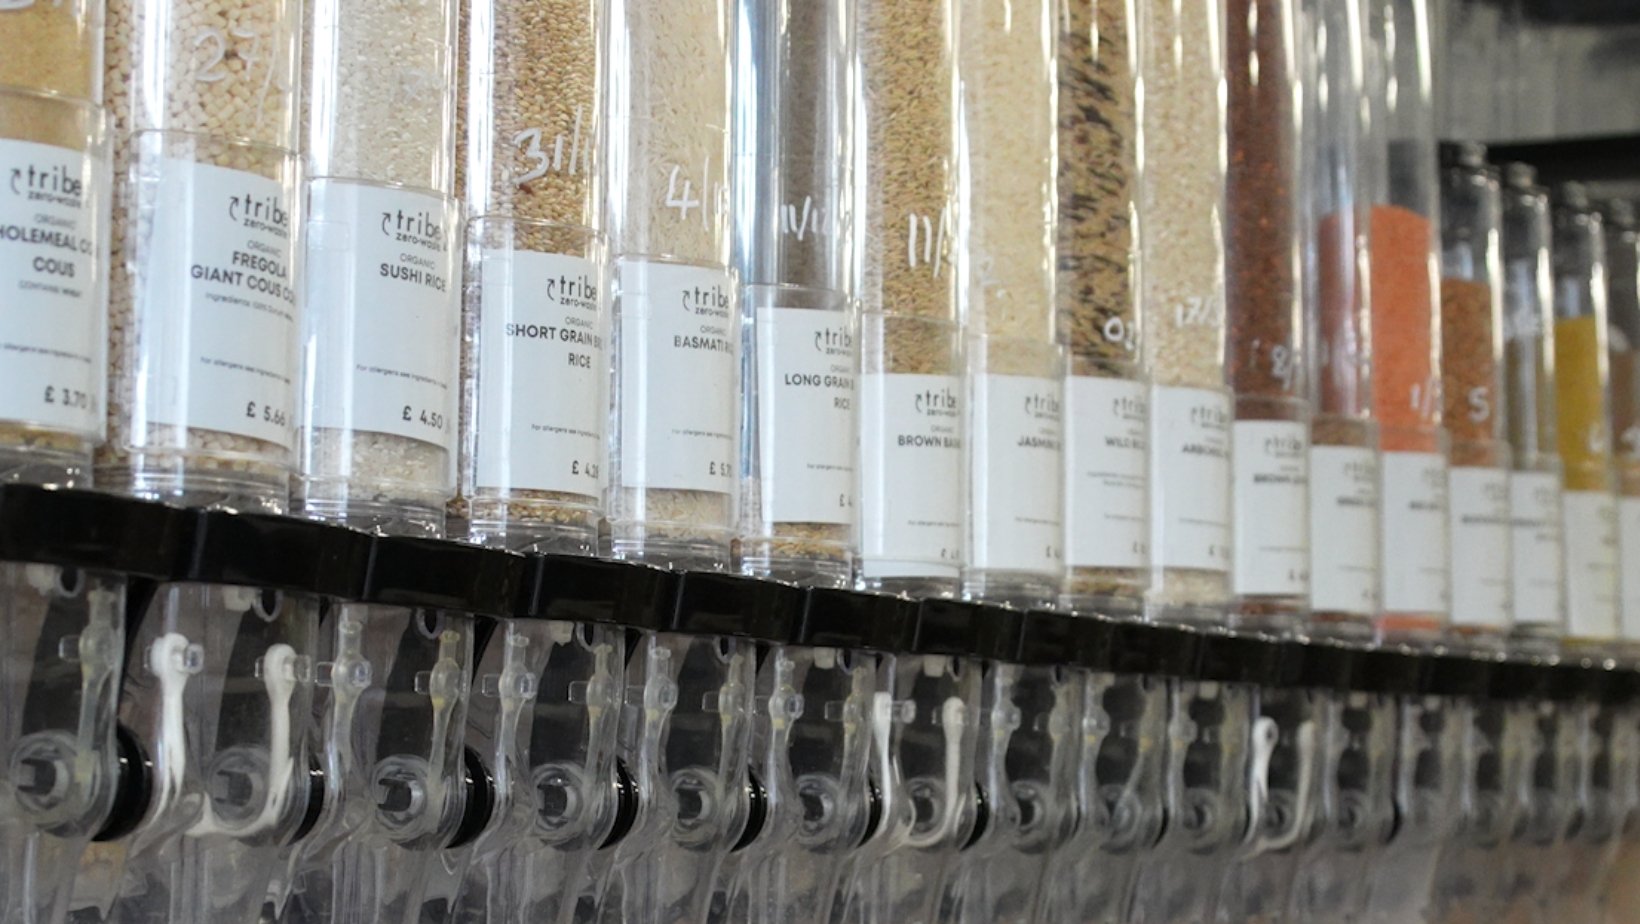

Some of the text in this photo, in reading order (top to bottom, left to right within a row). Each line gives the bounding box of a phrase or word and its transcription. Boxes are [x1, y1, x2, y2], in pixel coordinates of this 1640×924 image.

[27, 164, 82, 197] tribe
[33, 256, 75, 278] COUS
[399, 253, 436, 271] ORGANIC
[190, 264, 244, 286] GIANT
[246, 275, 281, 298] COUS
[379, 262, 446, 293] SUSHI RICE
[505, 322, 557, 341] SHORT
[559, 328, 593, 347] GRAIN
[673, 334, 724, 354] BASMATI
[567, 352, 592, 370] RICE
[784, 372, 822, 388] LONG
[44, 385, 55, 403] £
[246, 401, 256, 418] £
[402, 405, 443, 430] £ 4.50
[897, 434, 943, 448] BROWN
[571, 460, 580, 476] £
[708, 460, 717, 476] £
